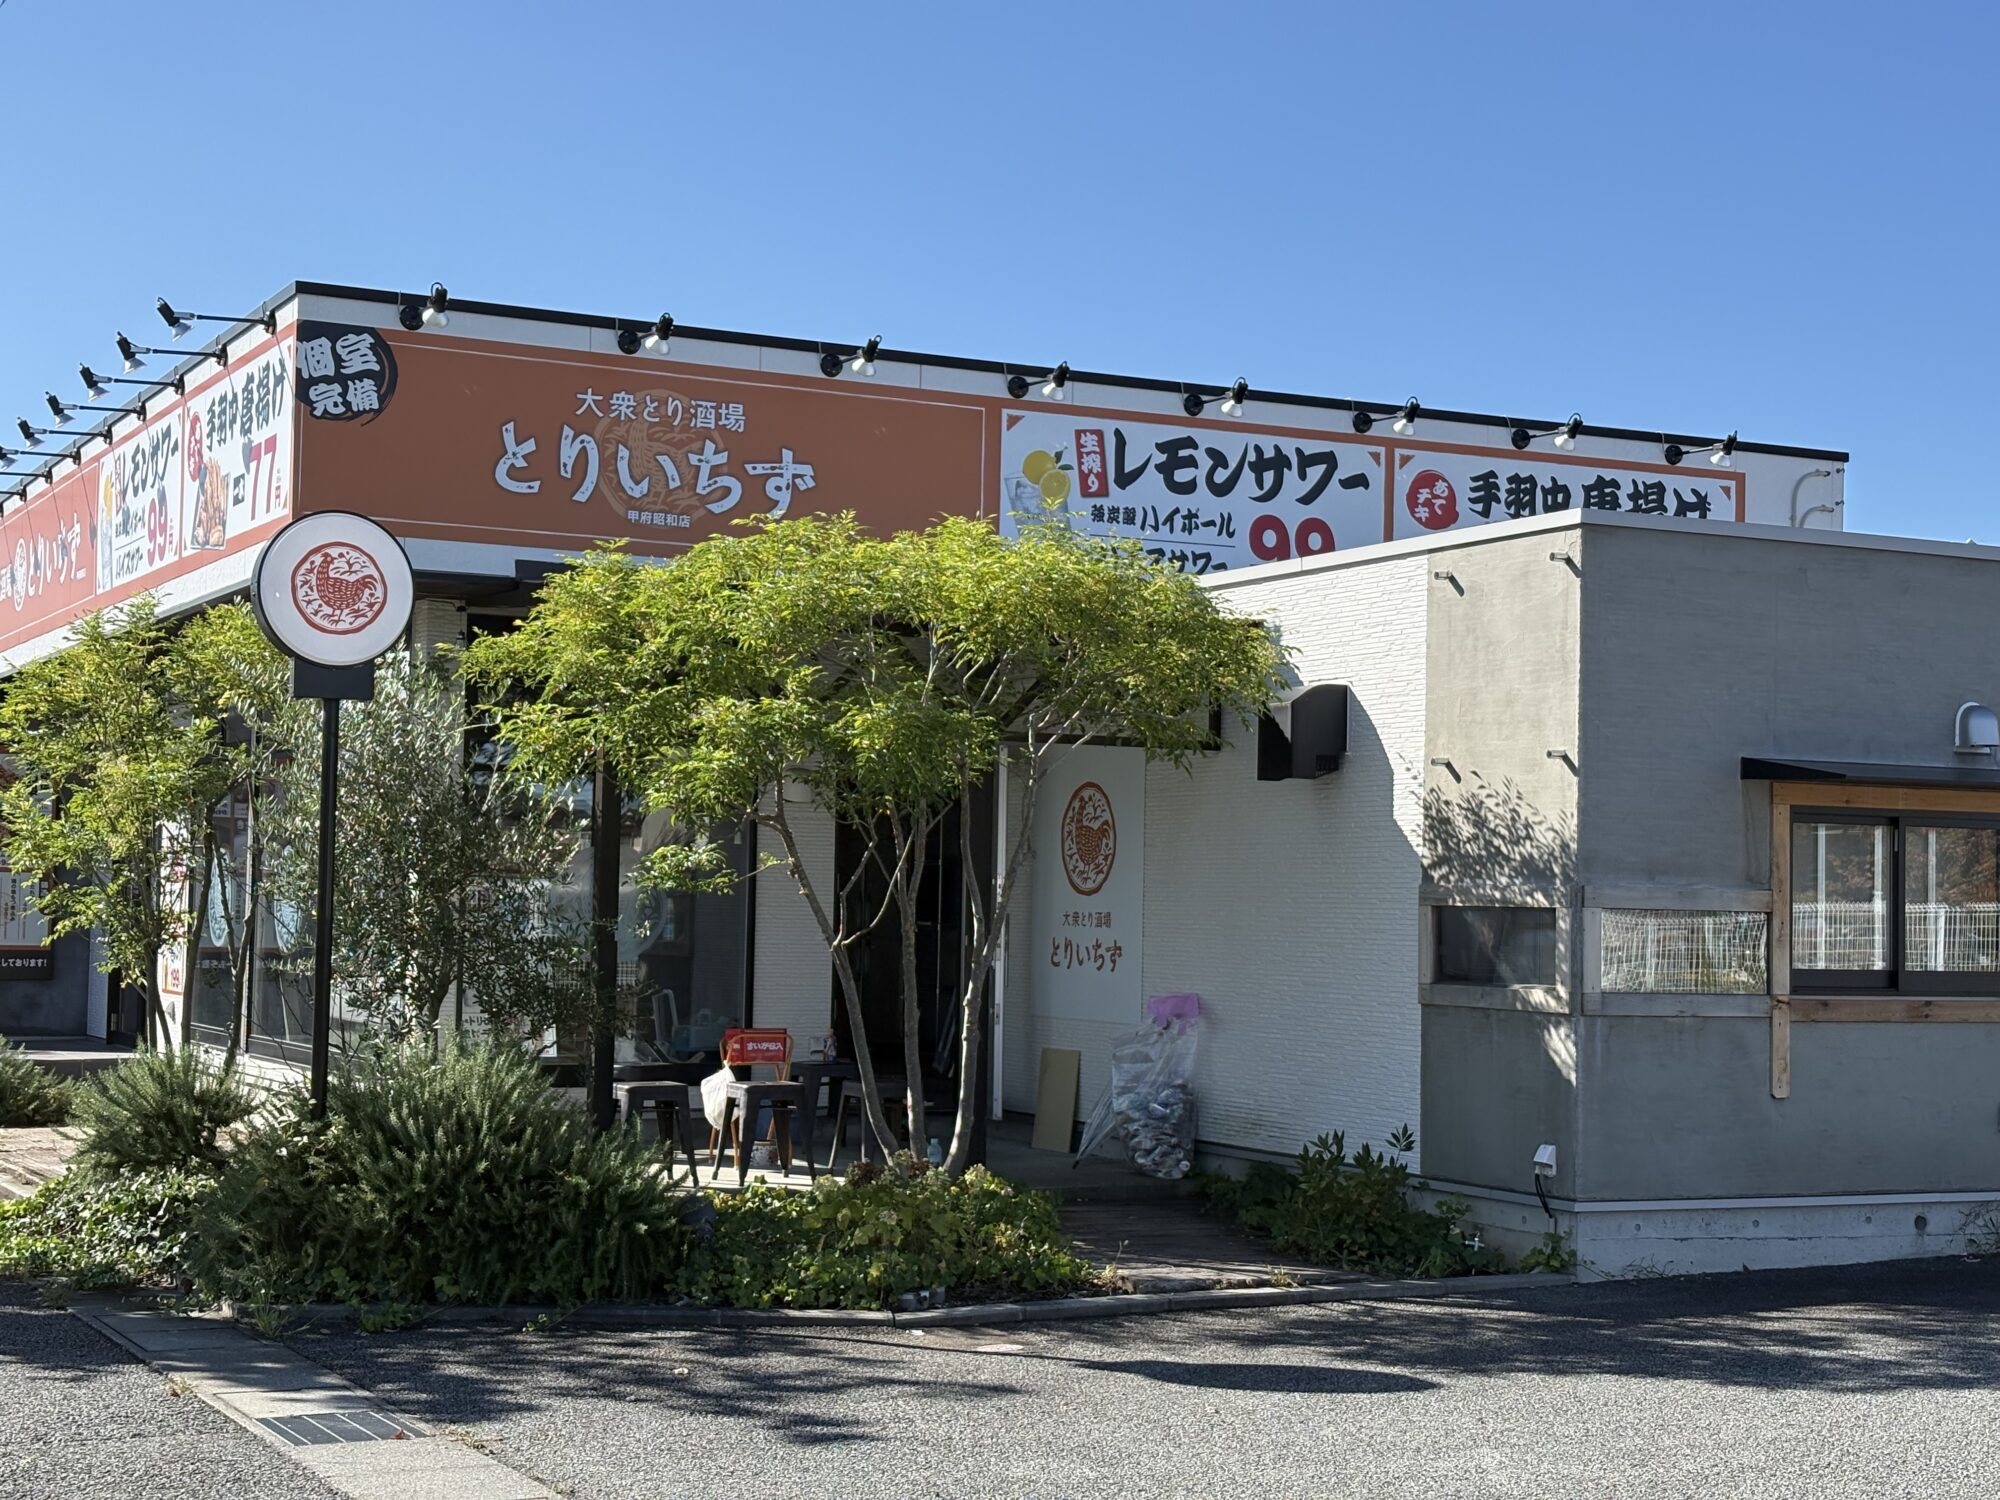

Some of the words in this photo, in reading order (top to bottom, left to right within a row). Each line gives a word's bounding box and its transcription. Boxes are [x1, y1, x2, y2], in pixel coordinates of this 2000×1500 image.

[296, 333, 380, 378] 個室
[308, 378, 379, 416] 完備
[575, 387, 746, 433] 大衆とり酒場
[122, 422, 179, 503] レモンサワー
[249, 433, 277, 521] 77
[494, 420, 817, 519] とりいちず
[1079, 431, 1102, 492] 生搾り
[1113, 427, 1370, 505] レモンサワー
[147, 497, 168, 568] 99
[627, 509, 691, 528] 甲府昭和店
[1091, 504, 1236, 539] 強炭酸ハイボール
[1062, 911, 1112, 929] 大衆とり酒場
[1050, 936, 1123, 973] とりいちず
